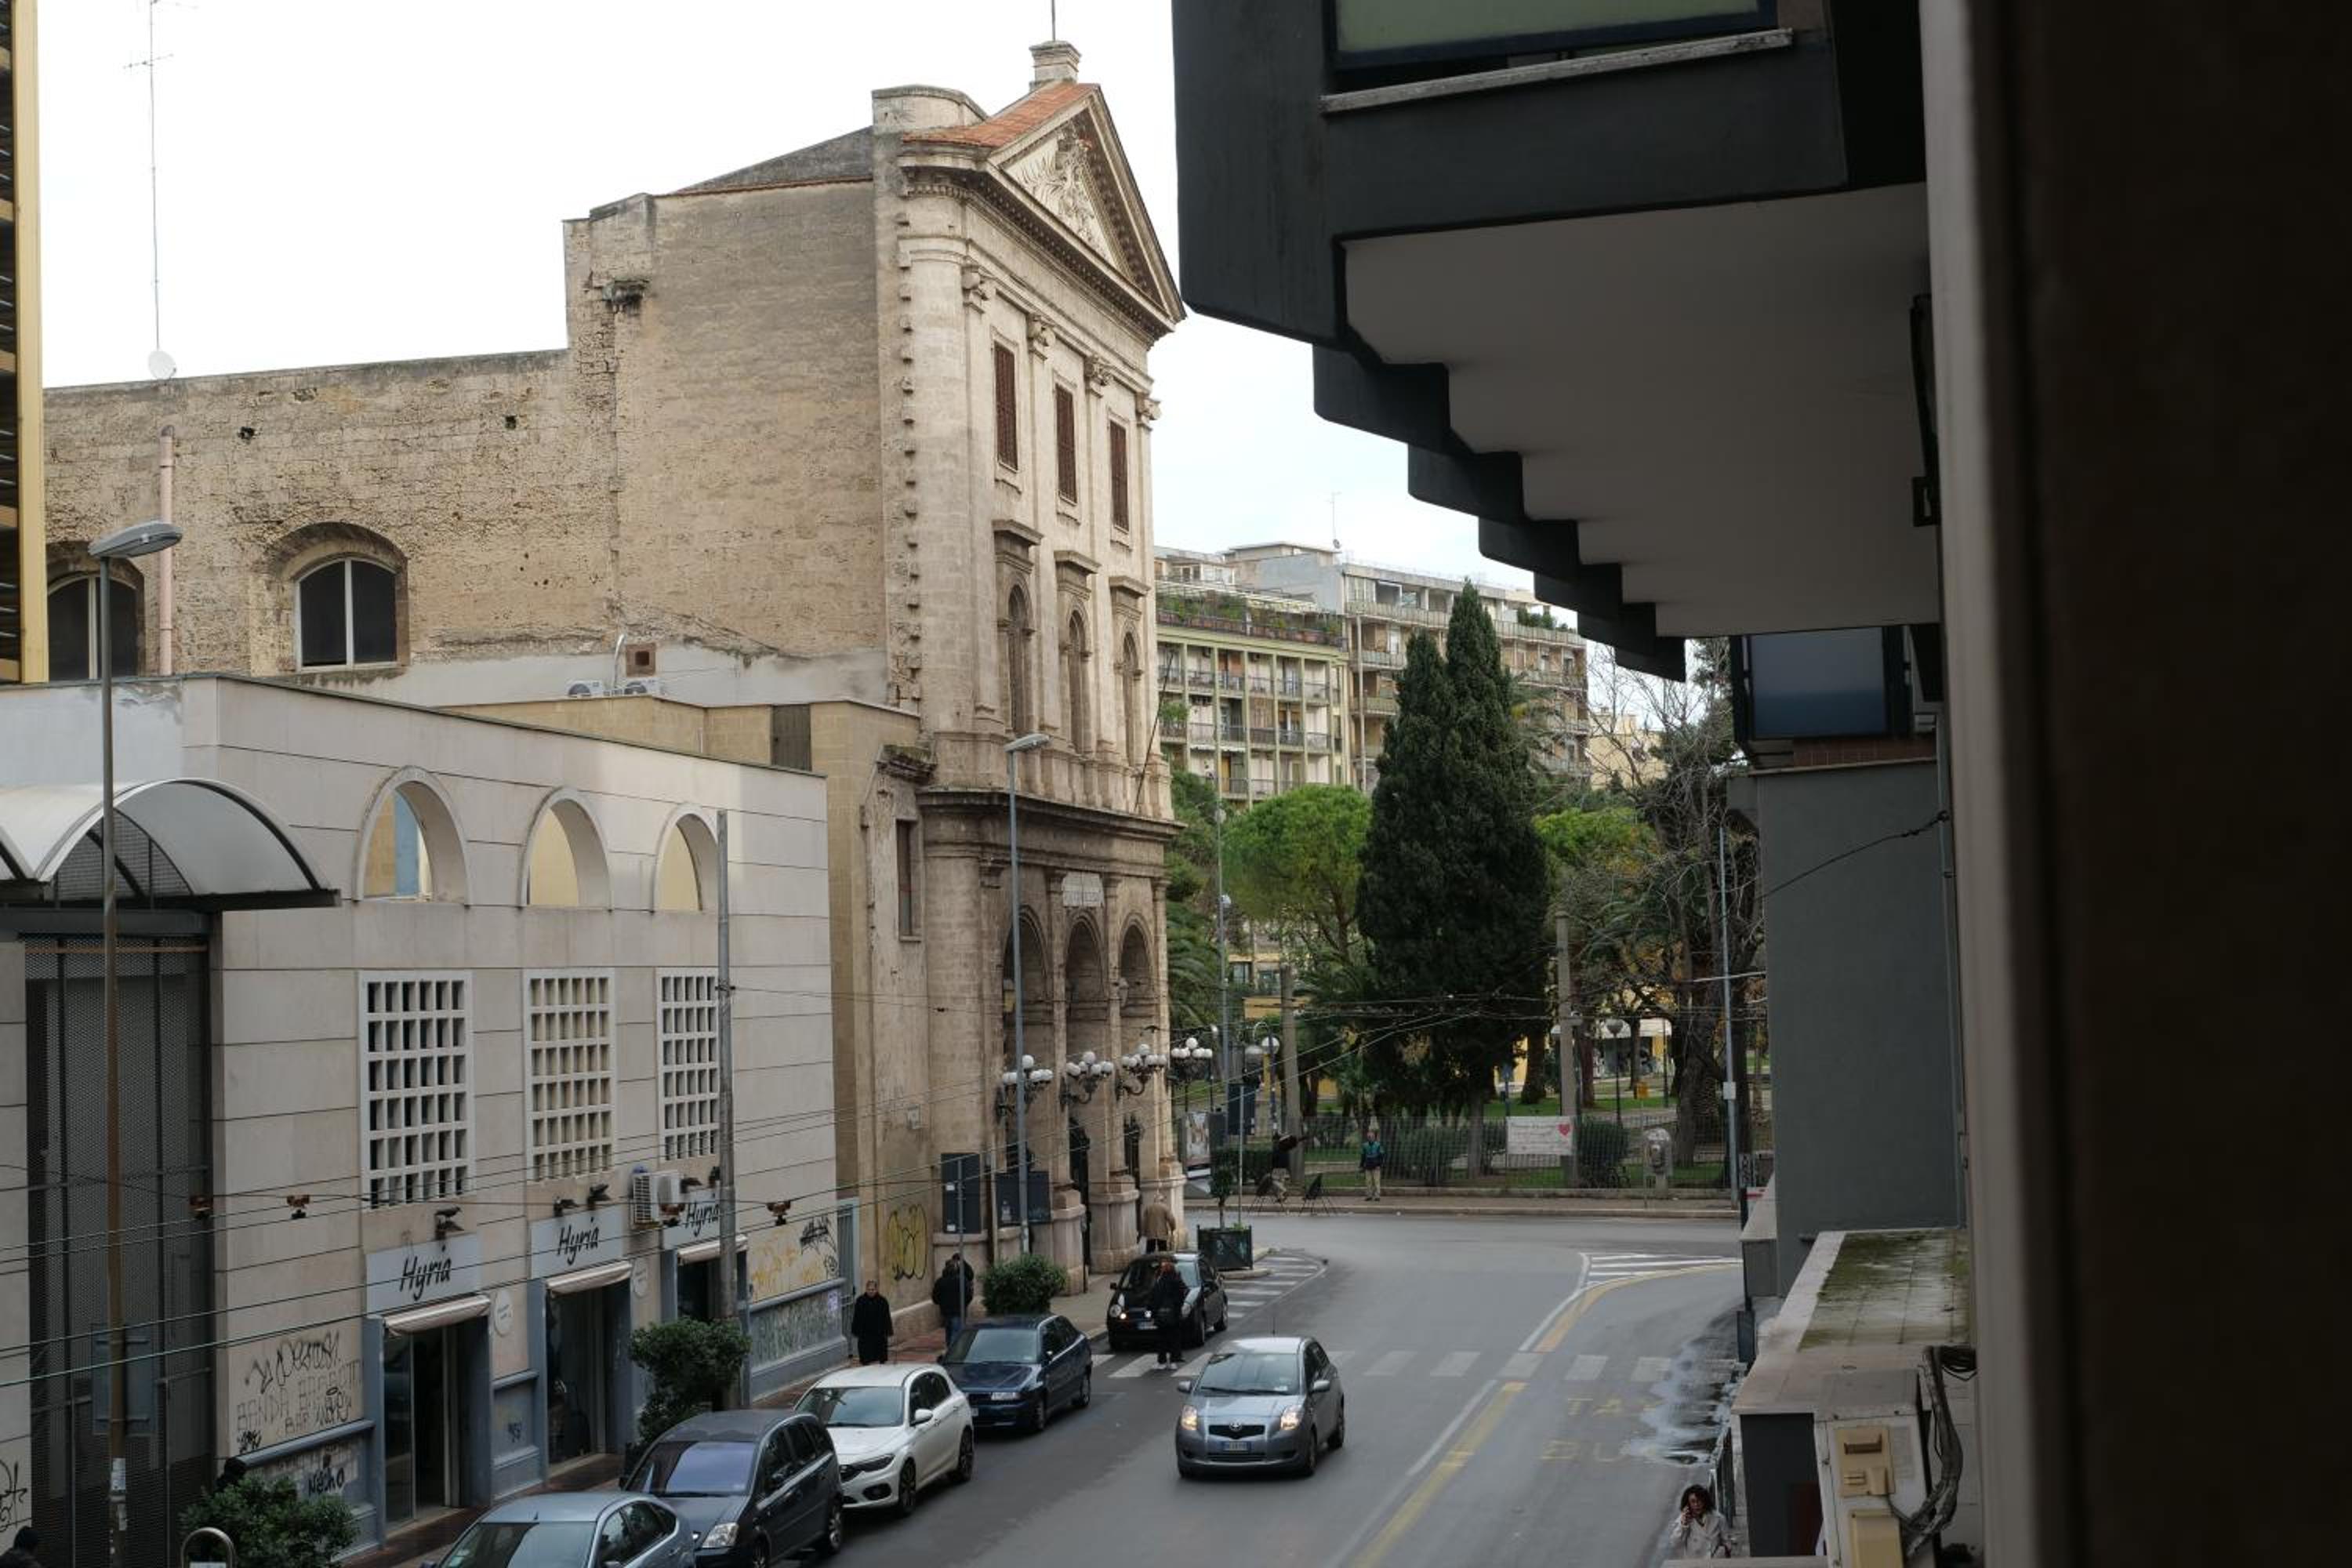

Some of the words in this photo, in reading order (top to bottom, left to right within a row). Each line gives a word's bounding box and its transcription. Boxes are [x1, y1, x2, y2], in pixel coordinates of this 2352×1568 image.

[684, 1192, 720, 1237] Hyria
[557, 1216, 600, 1265] Hyria
[400, 1243, 452, 1301] Hyria
